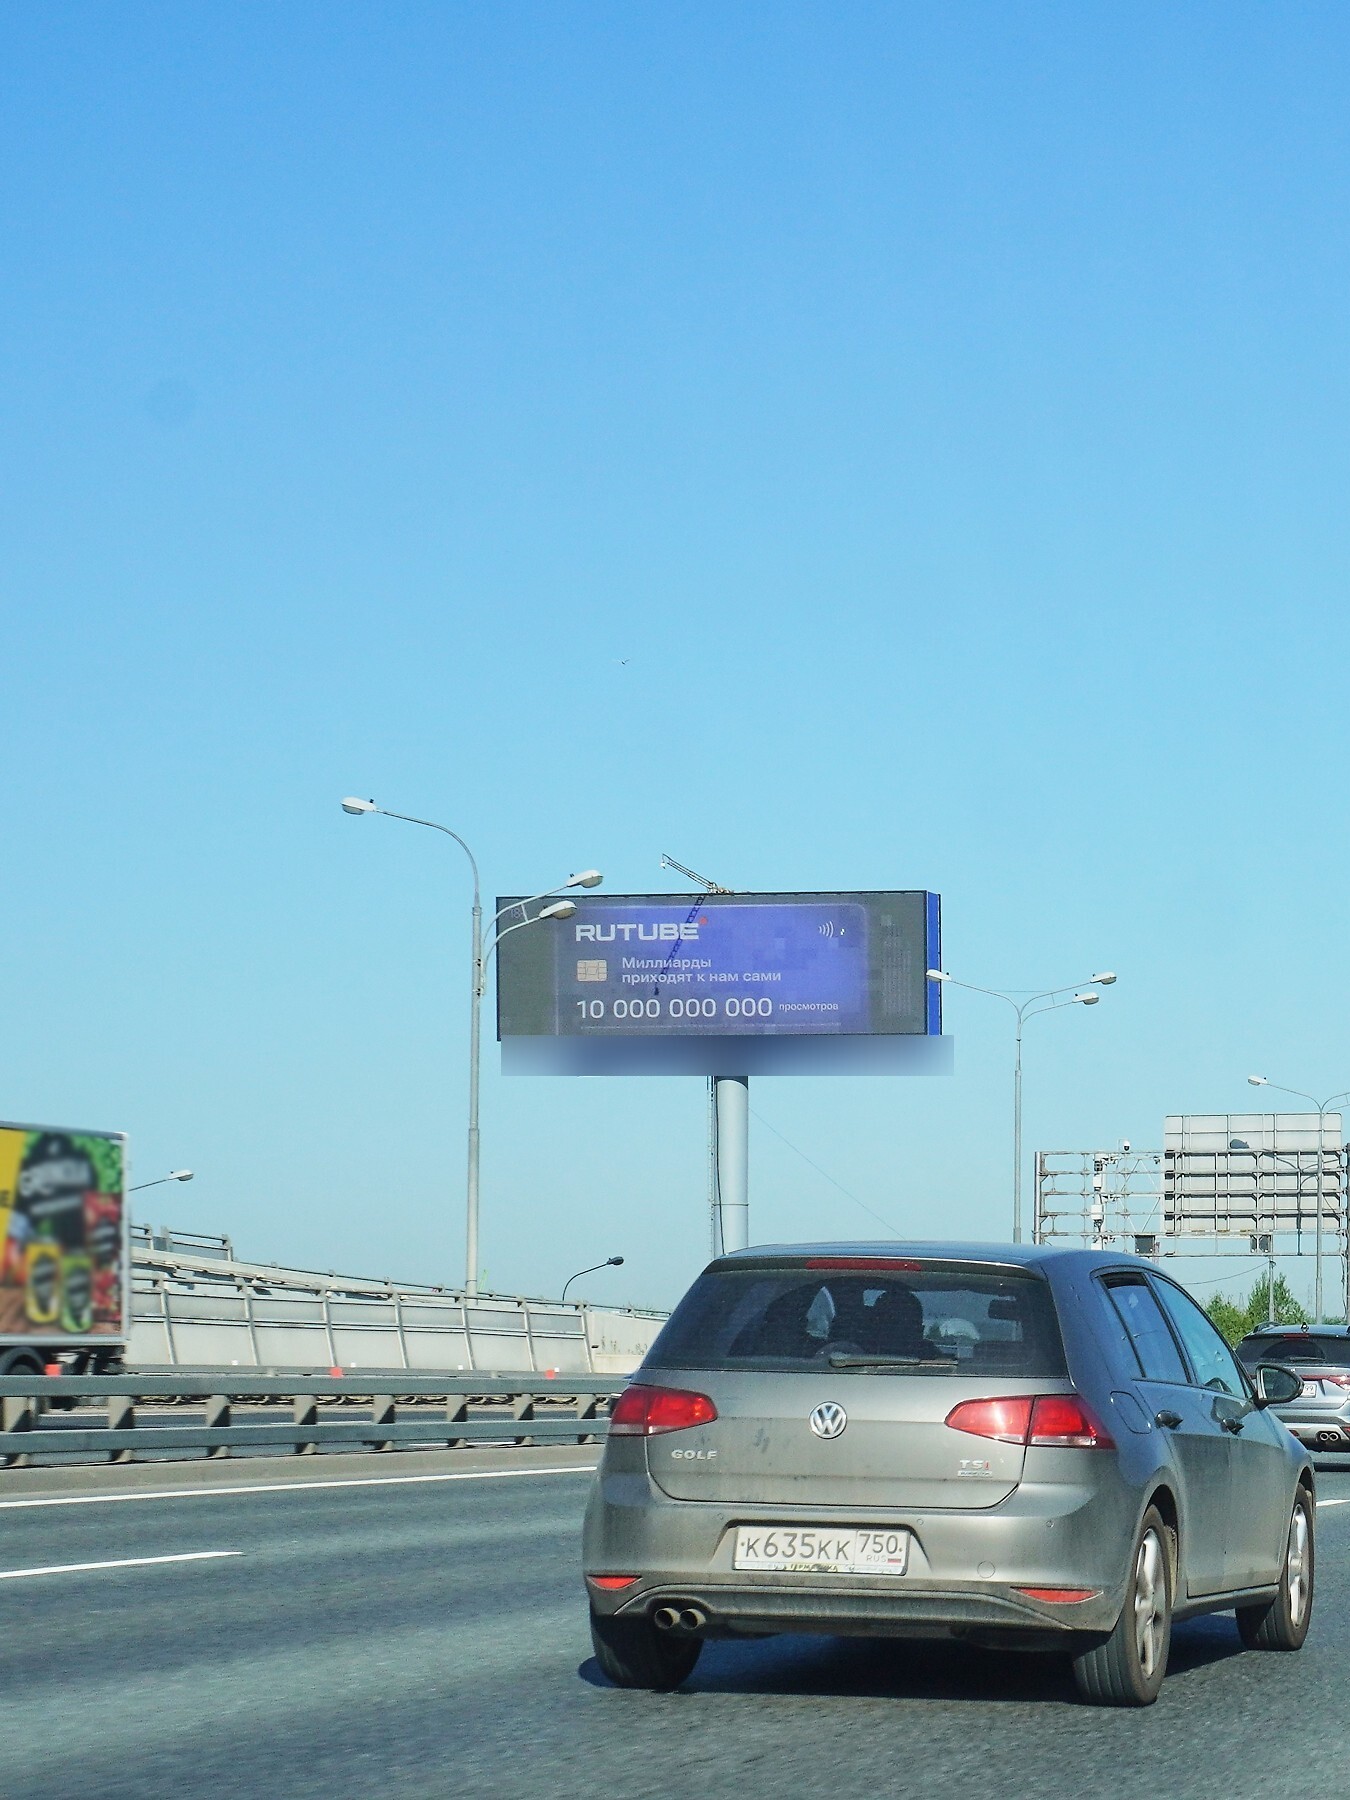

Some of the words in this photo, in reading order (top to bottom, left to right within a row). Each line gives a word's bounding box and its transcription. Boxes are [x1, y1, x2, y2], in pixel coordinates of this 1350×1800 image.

[575, 923, 699, 941] RUTUBE
[622, 957, 712, 969] Миллиарды
[622, 973, 693, 985] приходят
[697, 973, 706, 982] к
[709, 973, 739, 982] нам
[743, 972, 781, 982] сами
[577, 1000, 605, 1019] 10
[613, 999, 660, 1018] 000
[669, 998, 717, 1017] 000
[725, 998, 773, 1017] 000
[779, 1003, 839, 1013] просмотров
[671, 1449, 718, 1460] GOLF
[859, 1533, 898, 1555] 750
[866, 1554, 887, 1563] RUS
